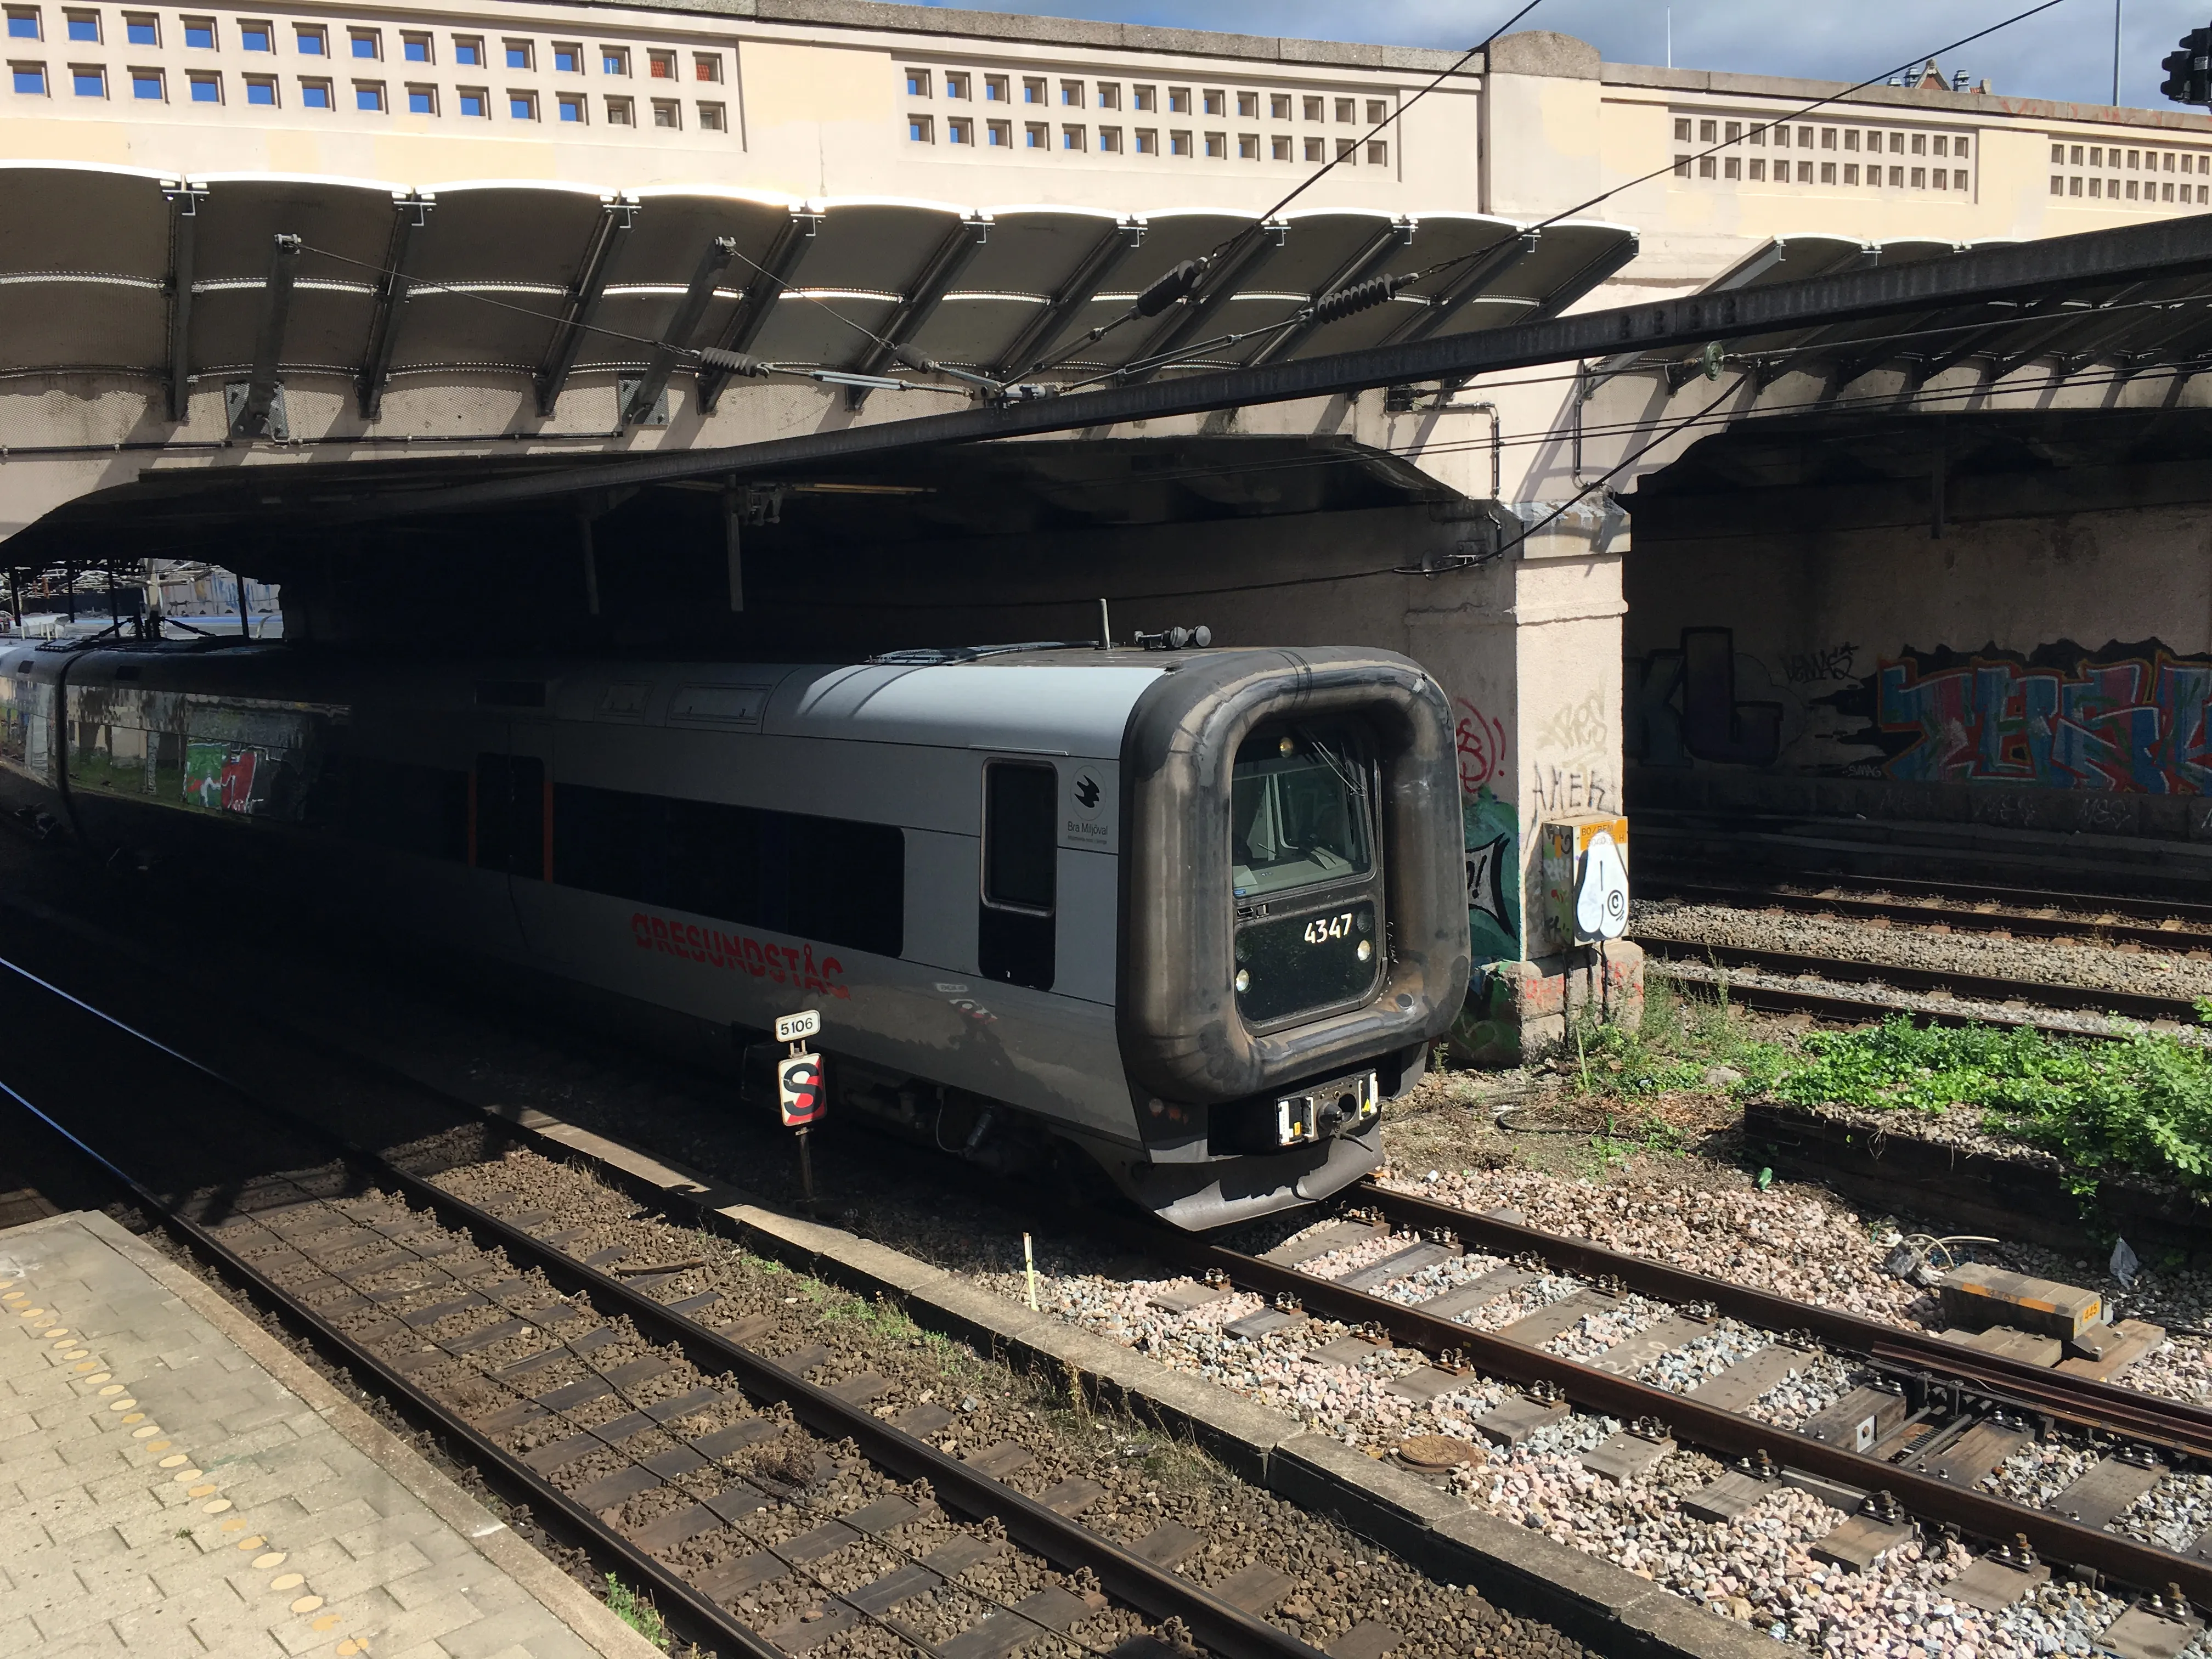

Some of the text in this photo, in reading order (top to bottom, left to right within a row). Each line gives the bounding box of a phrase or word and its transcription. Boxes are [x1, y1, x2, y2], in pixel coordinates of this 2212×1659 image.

[1068, 821, 1108, 836] Bra Miljöval
[1304, 912, 1352, 944] 4347
[780, 1017, 814, 1036] 5106
[783, 1062, 823, 1116] S
